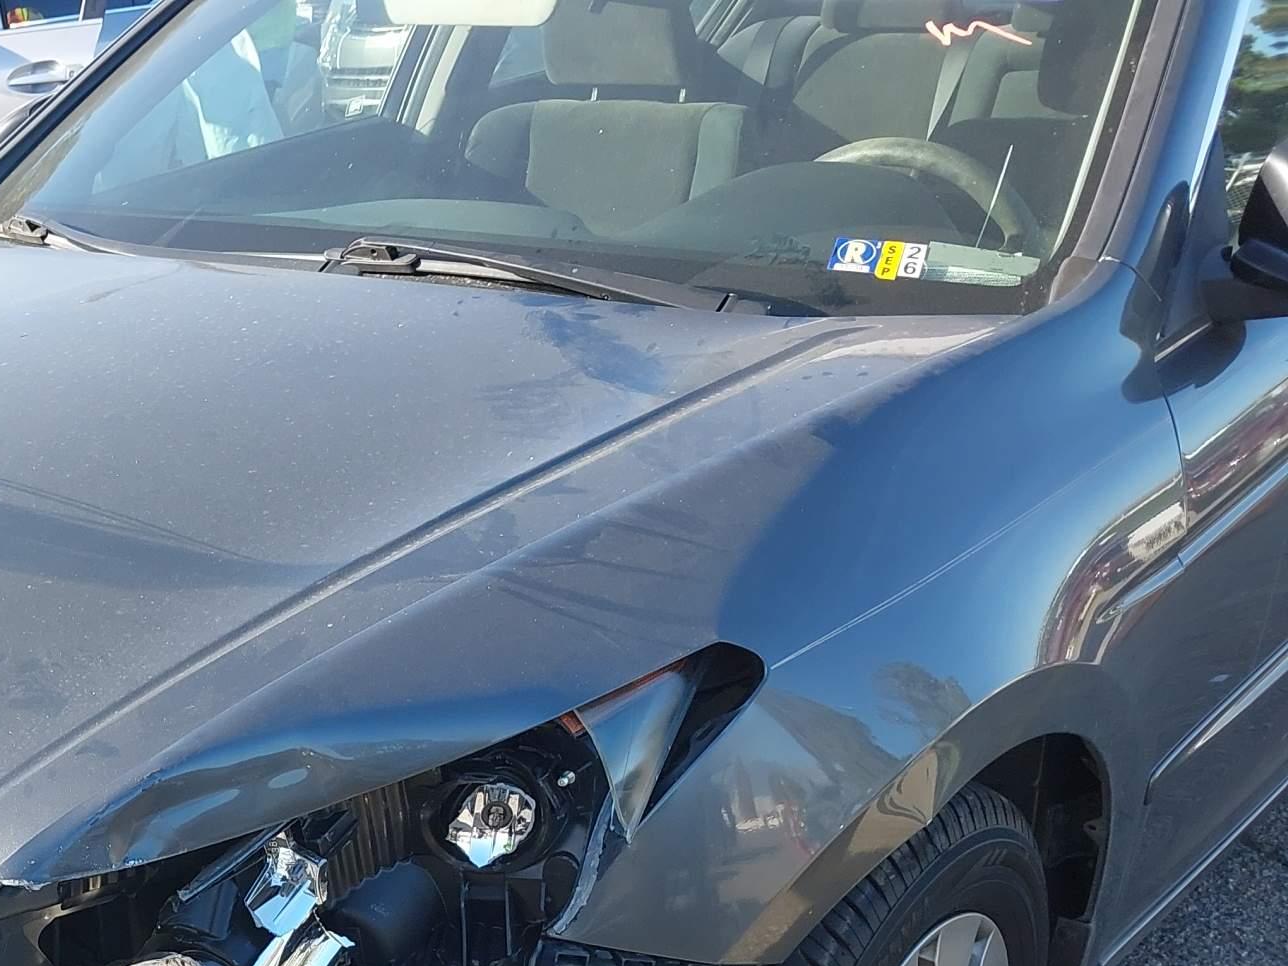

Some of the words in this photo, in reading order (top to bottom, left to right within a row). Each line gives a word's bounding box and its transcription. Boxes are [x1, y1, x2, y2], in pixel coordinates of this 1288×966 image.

[844, 241, 867, 264] R
[881, 245, 897, 276] SEP
[903, 246, 922, 275] 26
